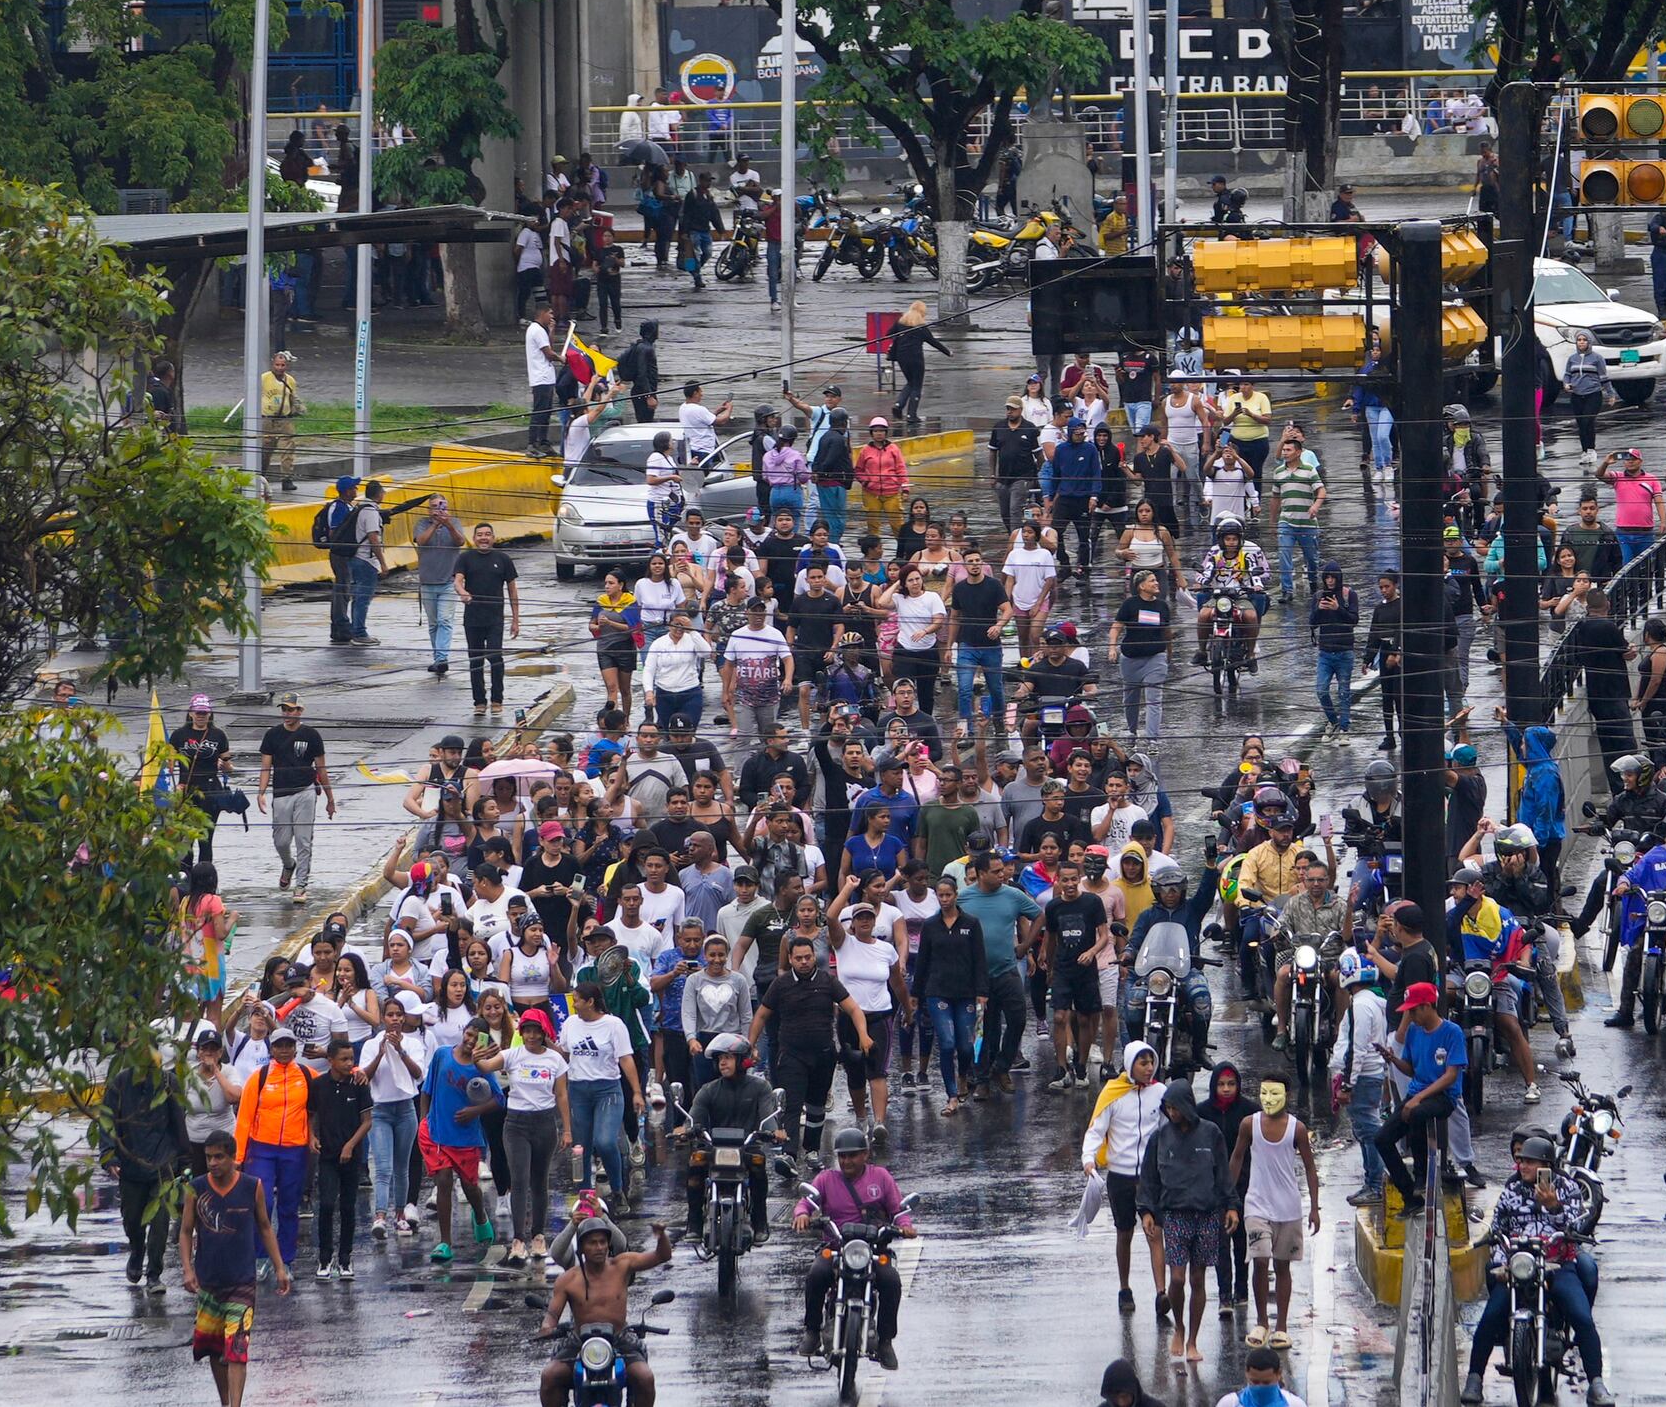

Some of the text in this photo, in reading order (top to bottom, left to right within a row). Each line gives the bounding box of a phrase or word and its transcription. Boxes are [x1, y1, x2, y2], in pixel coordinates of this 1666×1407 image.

[1420, 5, 1468, 14] ACCIONES
[1417, 24, 1470, 34] Y TACTICAS
[1423, 34, 1458, 51] DAET
[573, 1049, 599, 1057] adidas
